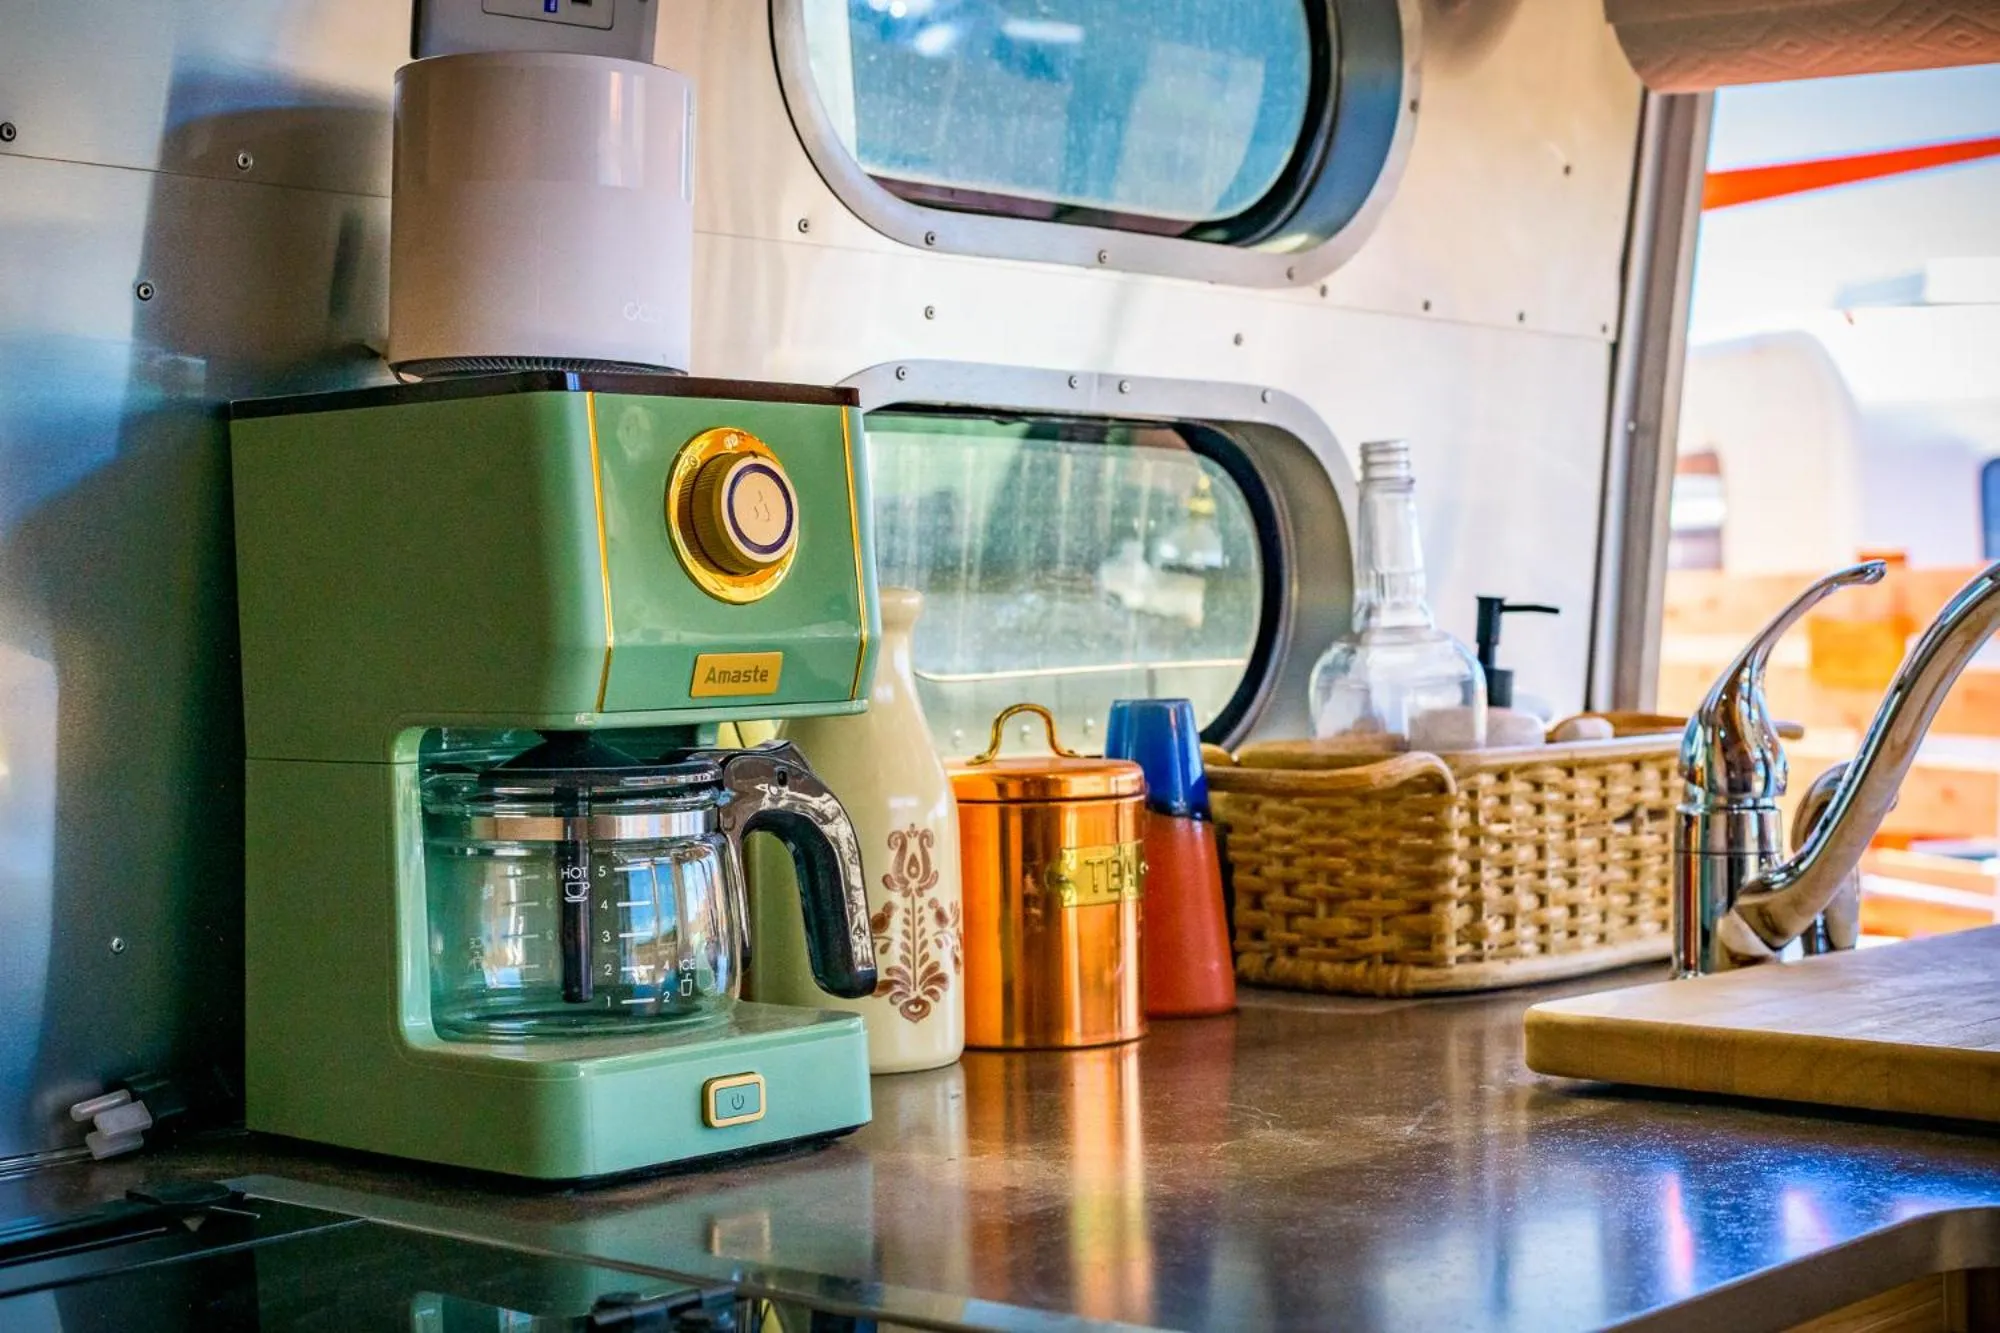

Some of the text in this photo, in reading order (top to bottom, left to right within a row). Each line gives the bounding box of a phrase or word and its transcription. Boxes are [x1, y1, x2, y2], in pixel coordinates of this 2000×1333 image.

[704, 664, 769, 685] Amaste
[561, 866, 588, 880] HOT
[598, 865, 606, 878] 5
[600, 899, 609, 911] 4
[602, 930, 611, 943] 3
[604, 963, 613, 976] 2
[663, 991, 670, 1003] 2
